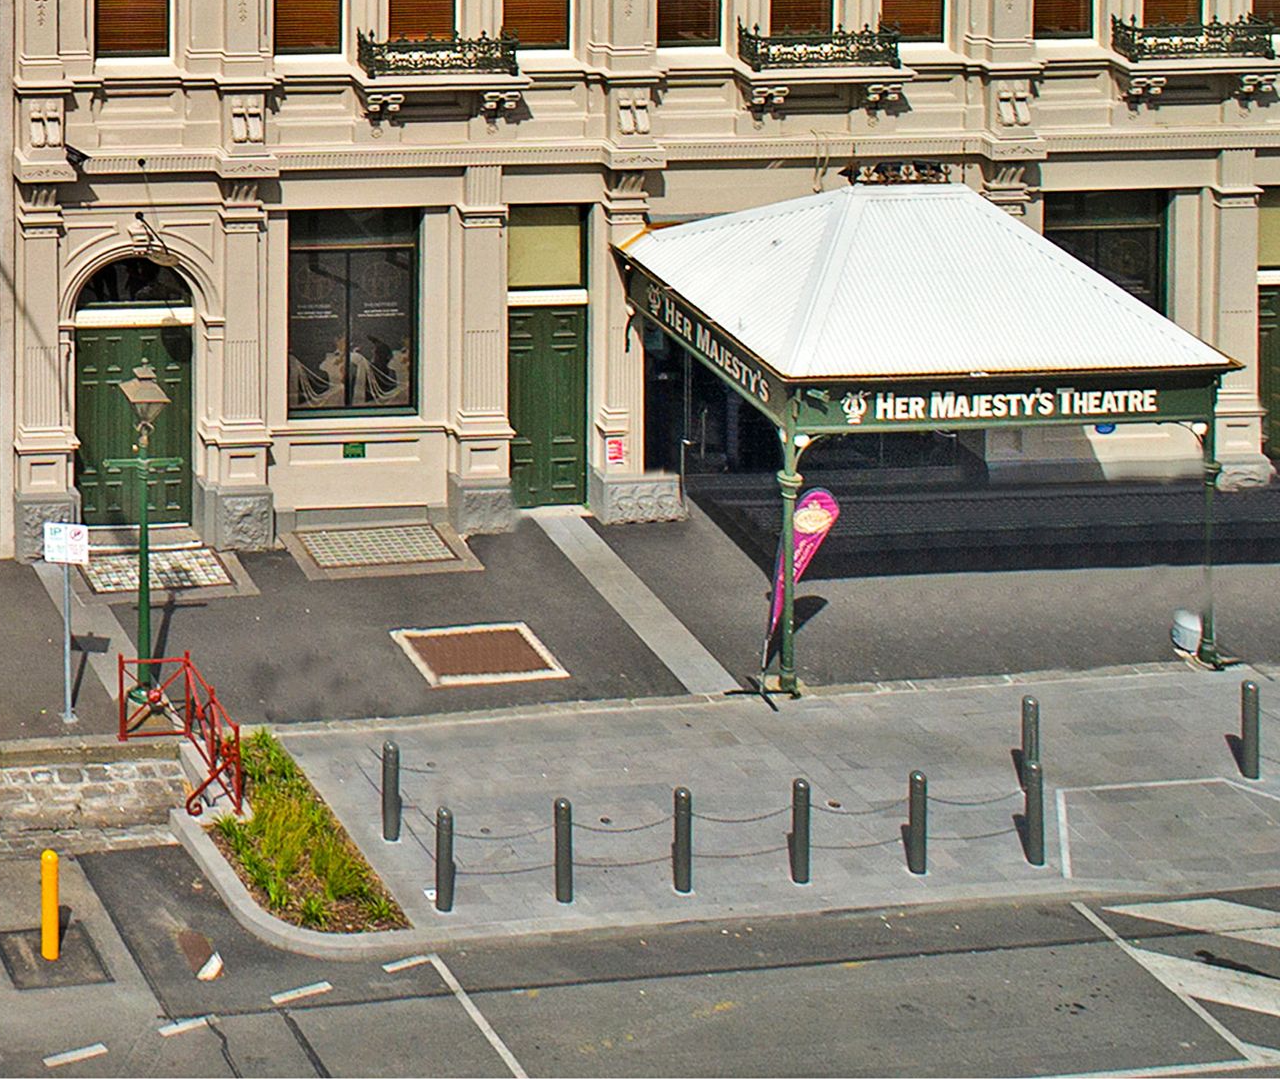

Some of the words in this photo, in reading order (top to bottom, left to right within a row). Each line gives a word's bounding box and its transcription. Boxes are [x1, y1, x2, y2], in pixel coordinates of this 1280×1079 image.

[665, 297, 692, 341] HER
[696, 323, 769, 403] MAJESTY'S
[875, 392, 925, 419] HER
[931, 388, 1054, 418] MAJESTY'S
[1057, 387, 1157, 415] THEATRE
